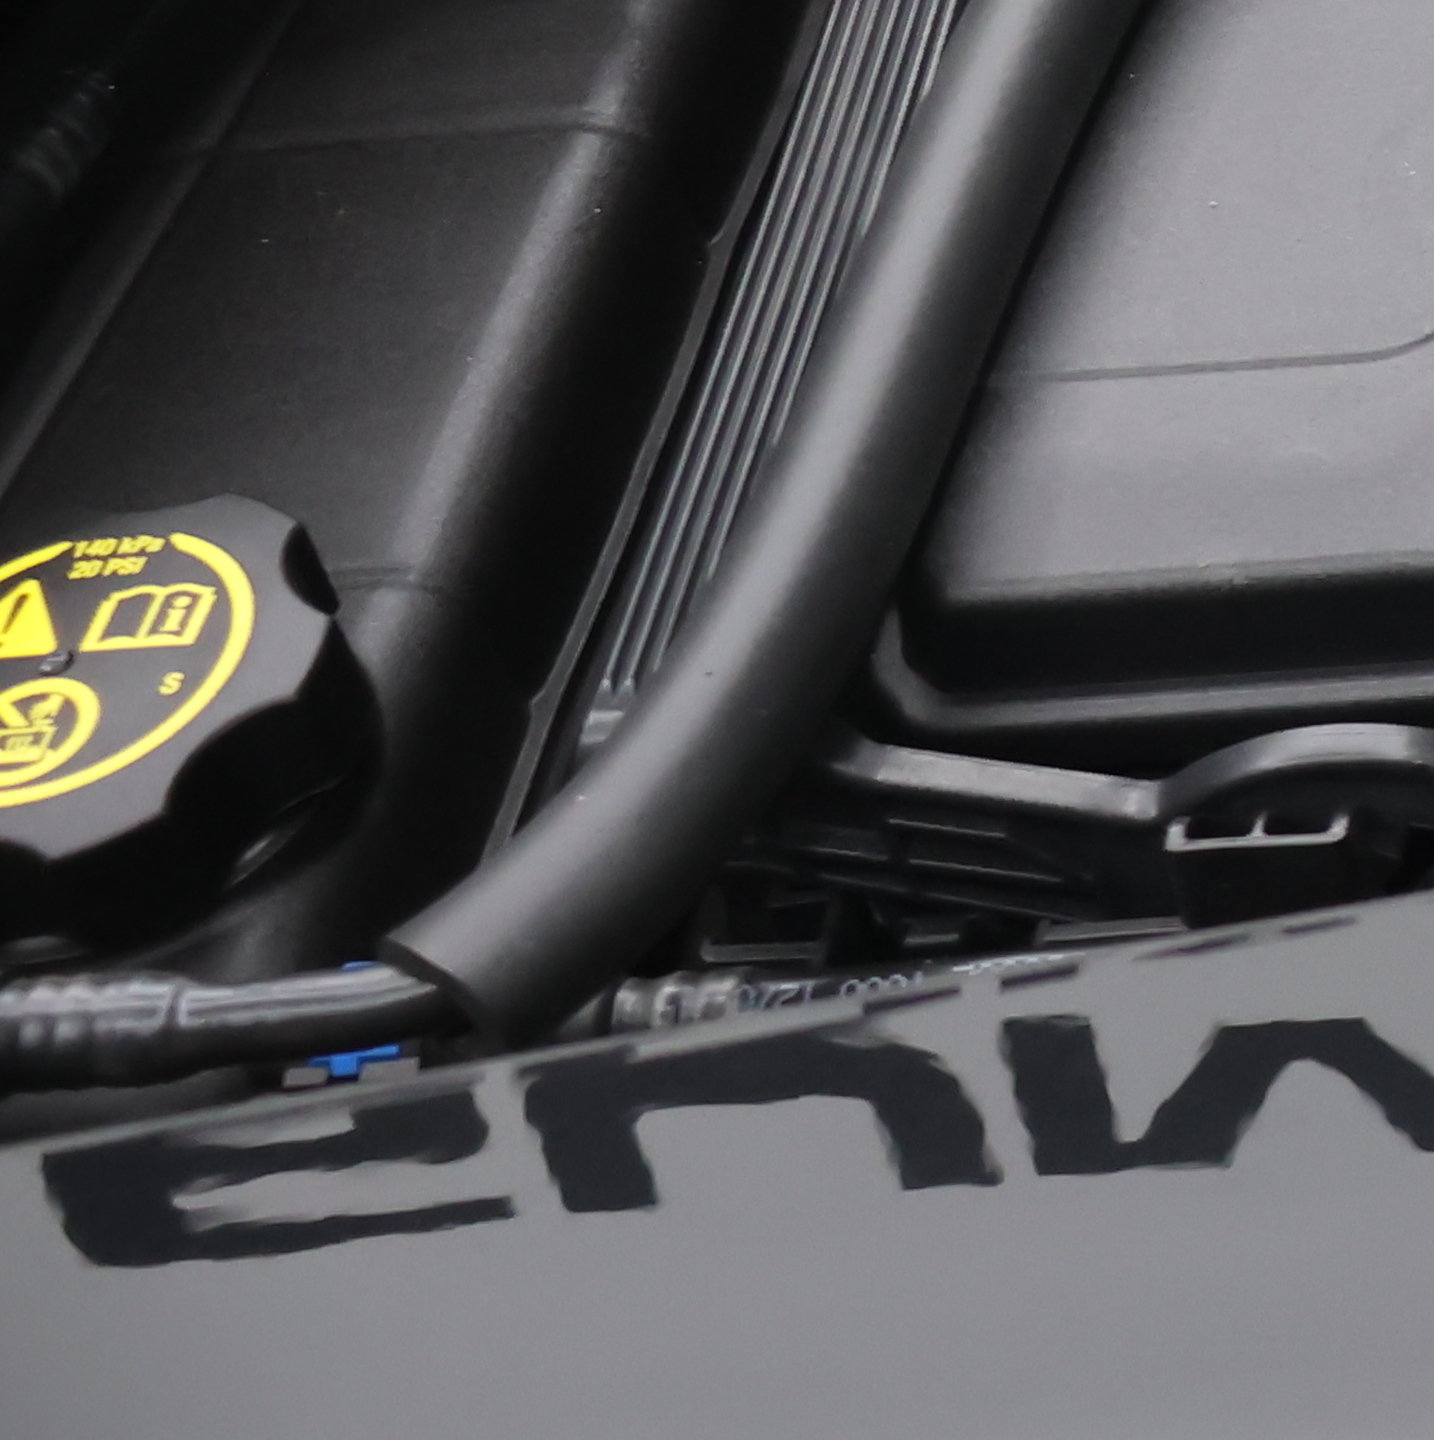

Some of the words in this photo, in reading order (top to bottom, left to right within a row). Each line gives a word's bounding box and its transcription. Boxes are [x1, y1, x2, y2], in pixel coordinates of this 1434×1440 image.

[73, 538, 118, 559] 140
[66, 558, 104, 580] 20
[101, 556, 149, 577] PSI
[158, 671, 186, 696] S
